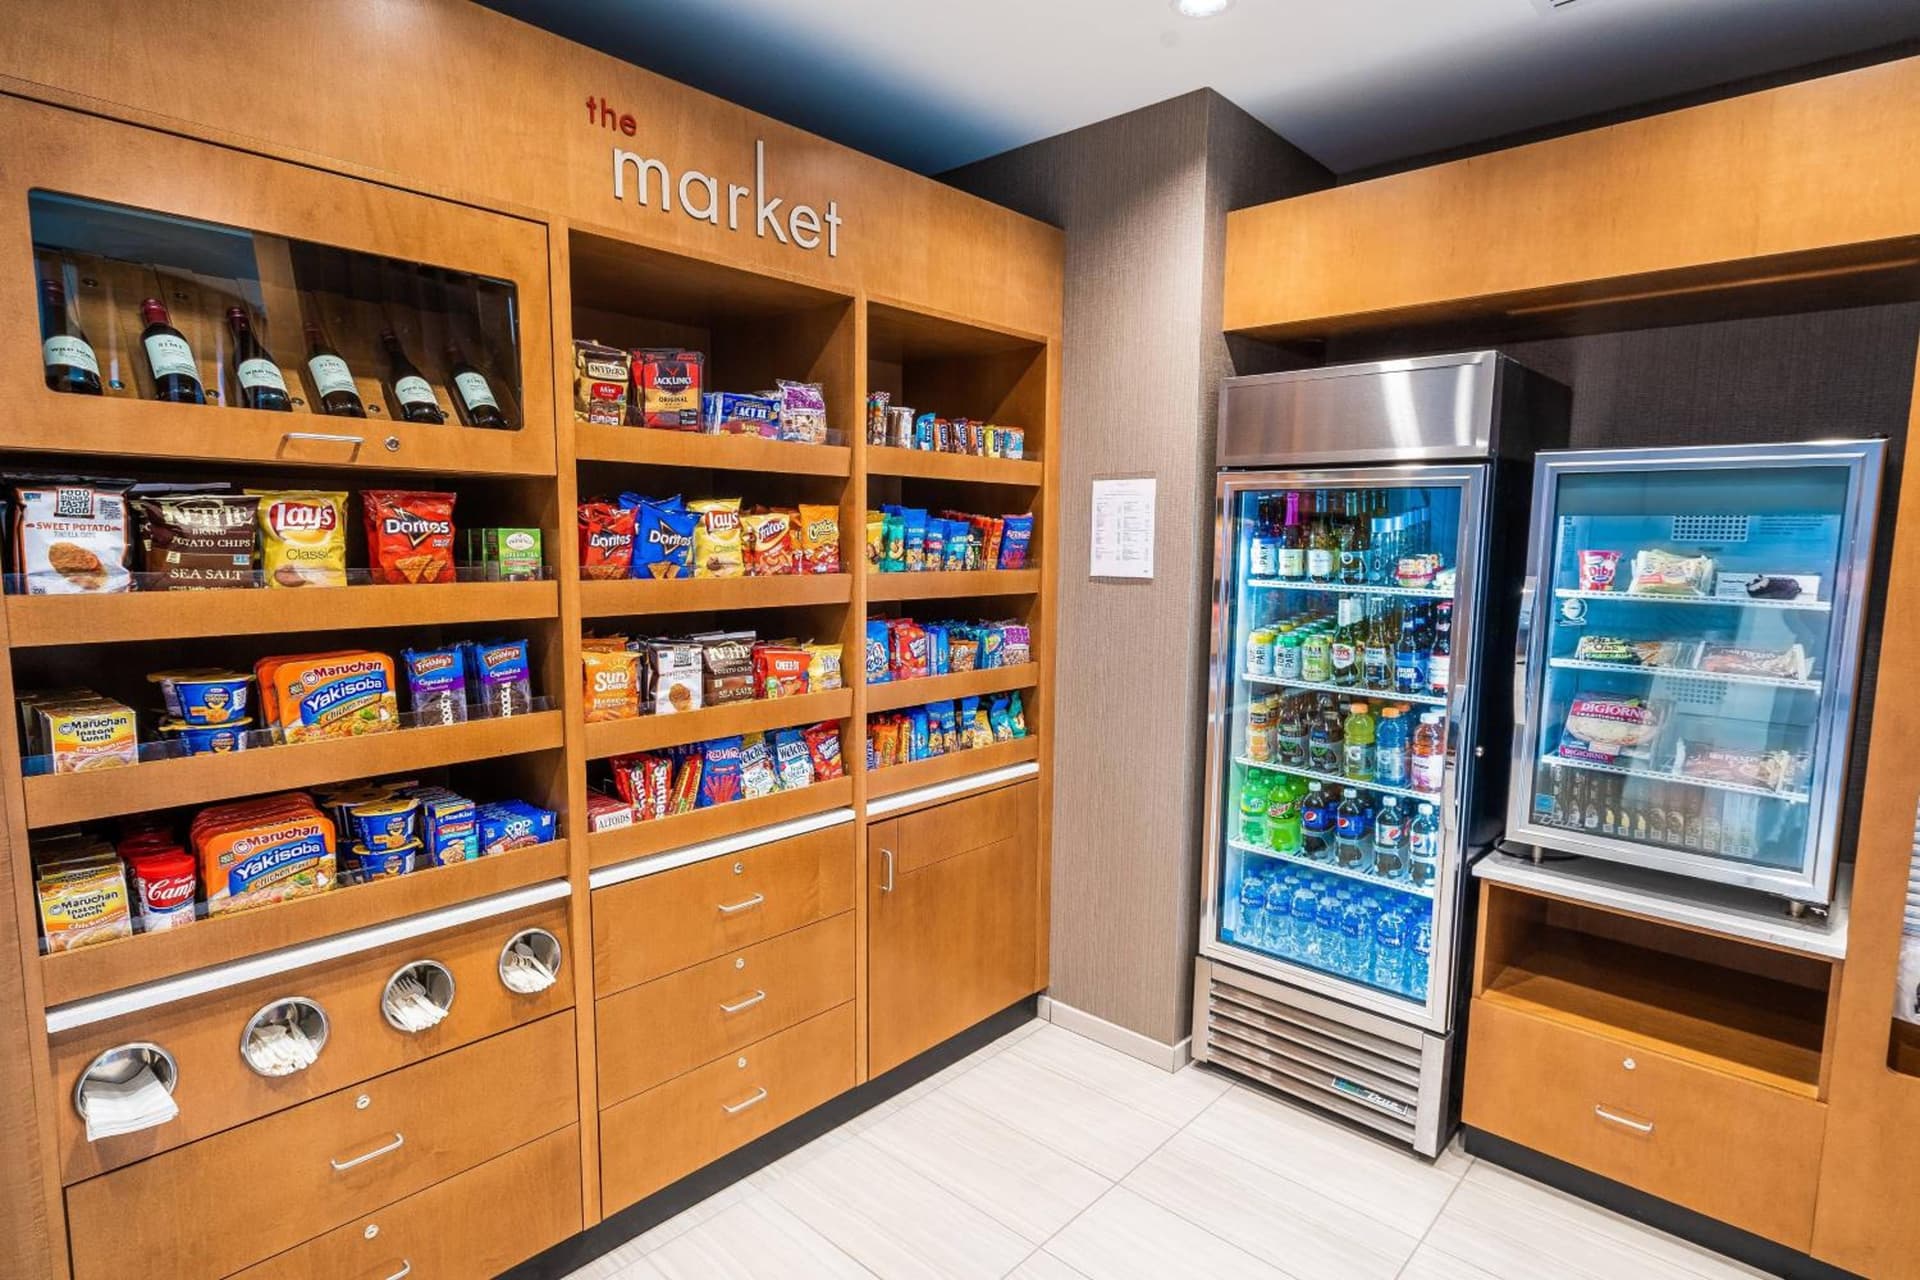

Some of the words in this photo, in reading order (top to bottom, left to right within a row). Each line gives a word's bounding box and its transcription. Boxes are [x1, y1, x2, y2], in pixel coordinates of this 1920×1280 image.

[586, 96, 637, 137] the
[613, 140, 842, 257] market
[275, 503, 333, 532] Lay's
[708, 511, 739, 532] Lay's
[36, 522, 72, 532] SWEET
[73, 522, 112, 532] POTATO
[384, 518, 450, 535] Doritos
[217, 538, 251, 548] CHIPS
[591, 533, 631, 548] Doritos
[648, 529, 694, 547] Doritos
[170, 567, 201, 580] SEA
[204, 569, 244, 580] SALT
[314, 660, 383, 678] Maruchan
[595, 671, 629, 692] Sun
[307, 676, 383, 714] Yakisoba
[72, 716, 128, 729] Maruchan
[75, 727, 115, 737] Instant
[81, 733, 112, 742] Lunch
[741, 743, 765, 764] elch's
[505, 819, 533, 836] POP
[598, 813, 630, 830] ALTOIDS
[246, 825, 319, 847] Maruchan
[236, 842, 321, 880] Yakisoba
[61, 890, 119, 910] Maruchan
[66, 902, 106, 916] Instant
[72, 908, 103, 920] Lunch
